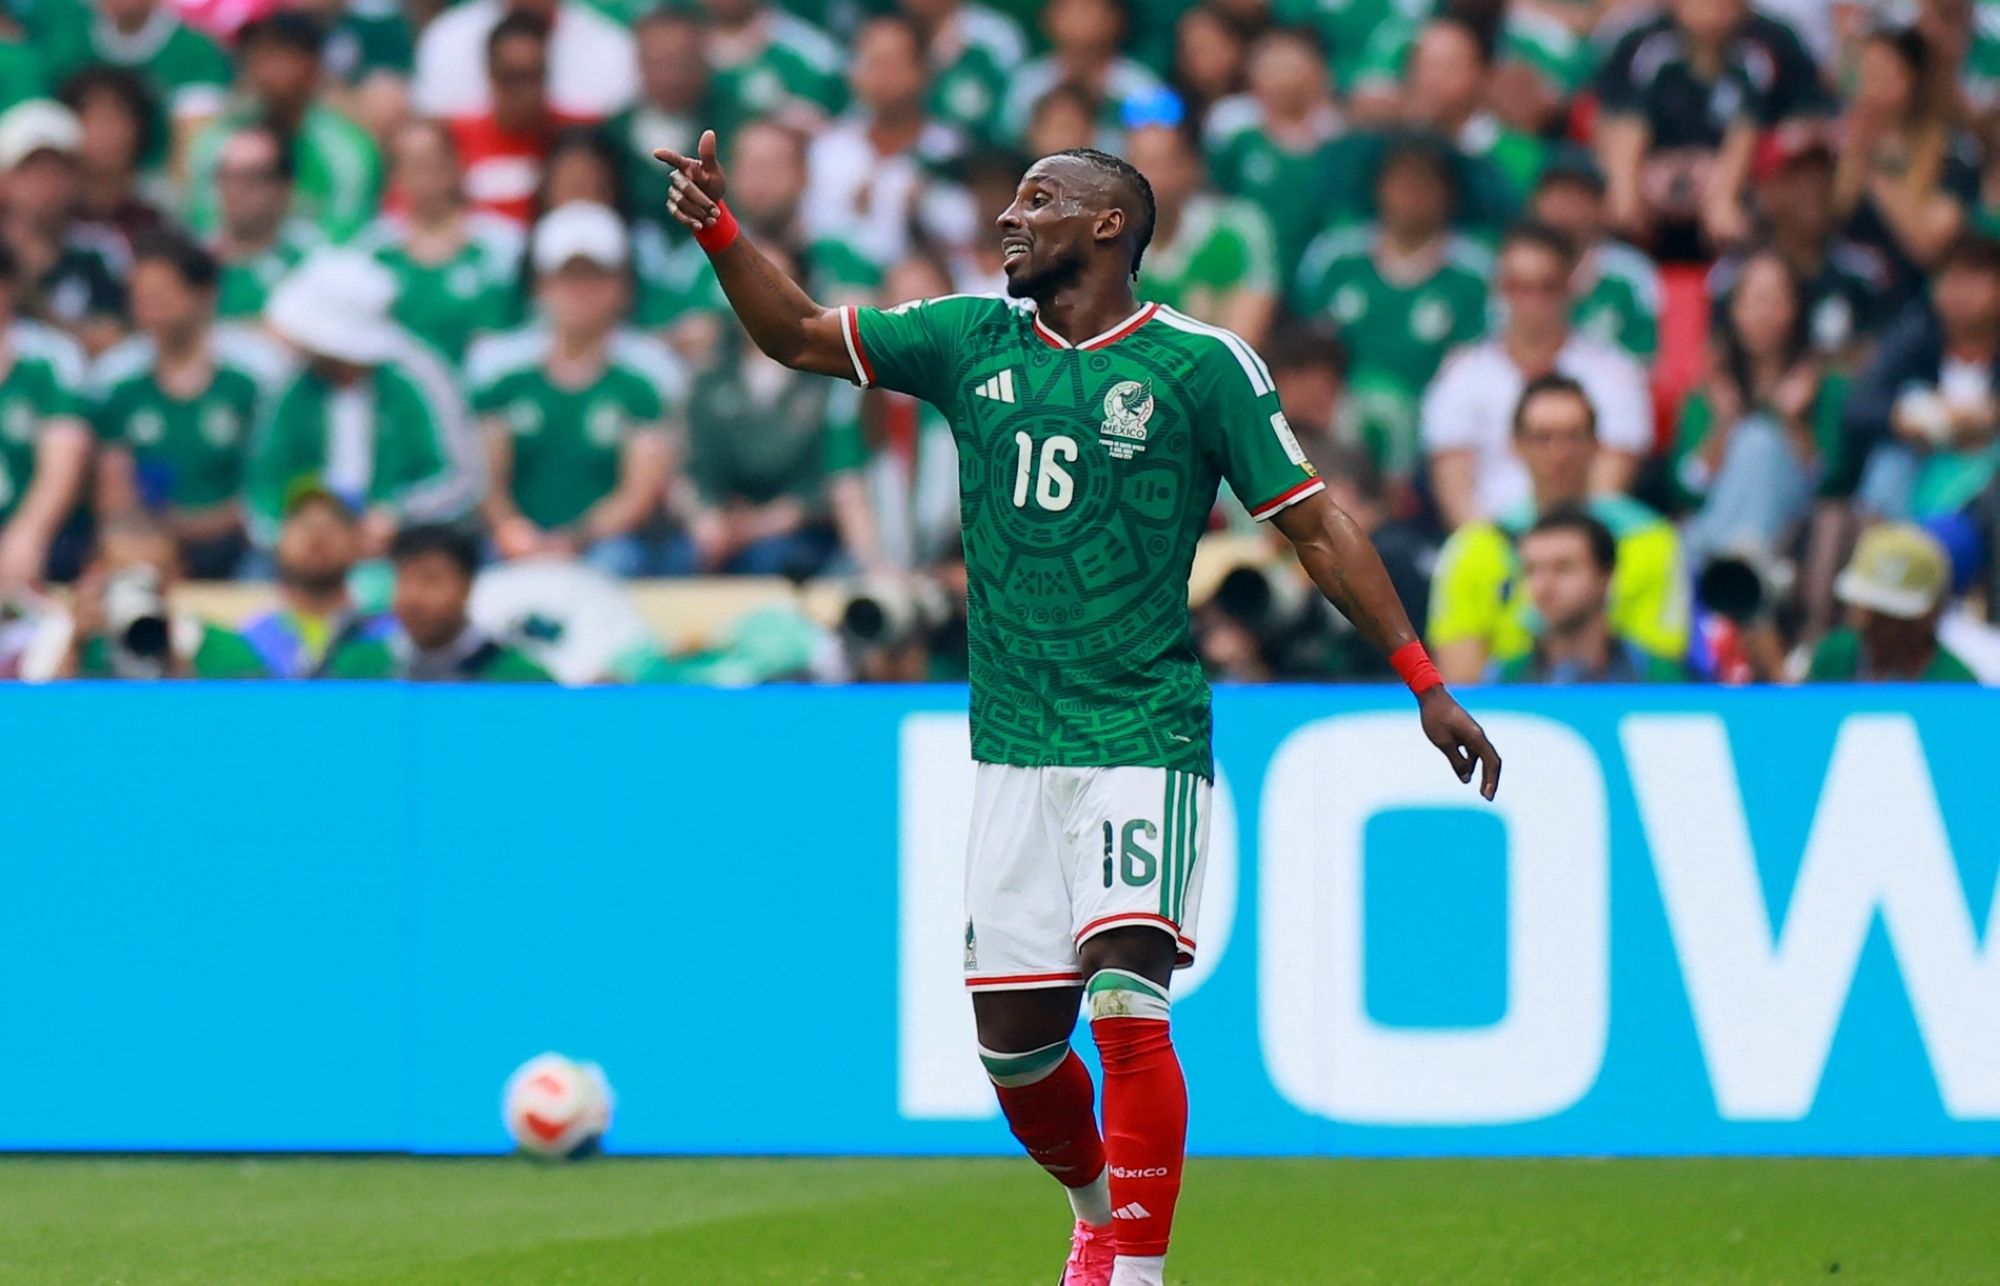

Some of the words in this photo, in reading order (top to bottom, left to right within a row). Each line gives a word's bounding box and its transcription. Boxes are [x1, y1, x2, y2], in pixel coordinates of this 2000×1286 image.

[1102, 424, 1145, 438] MÉXICO
[1013, 430, 1078, 511] 16
[1102, 818, 1158, 889] 16
